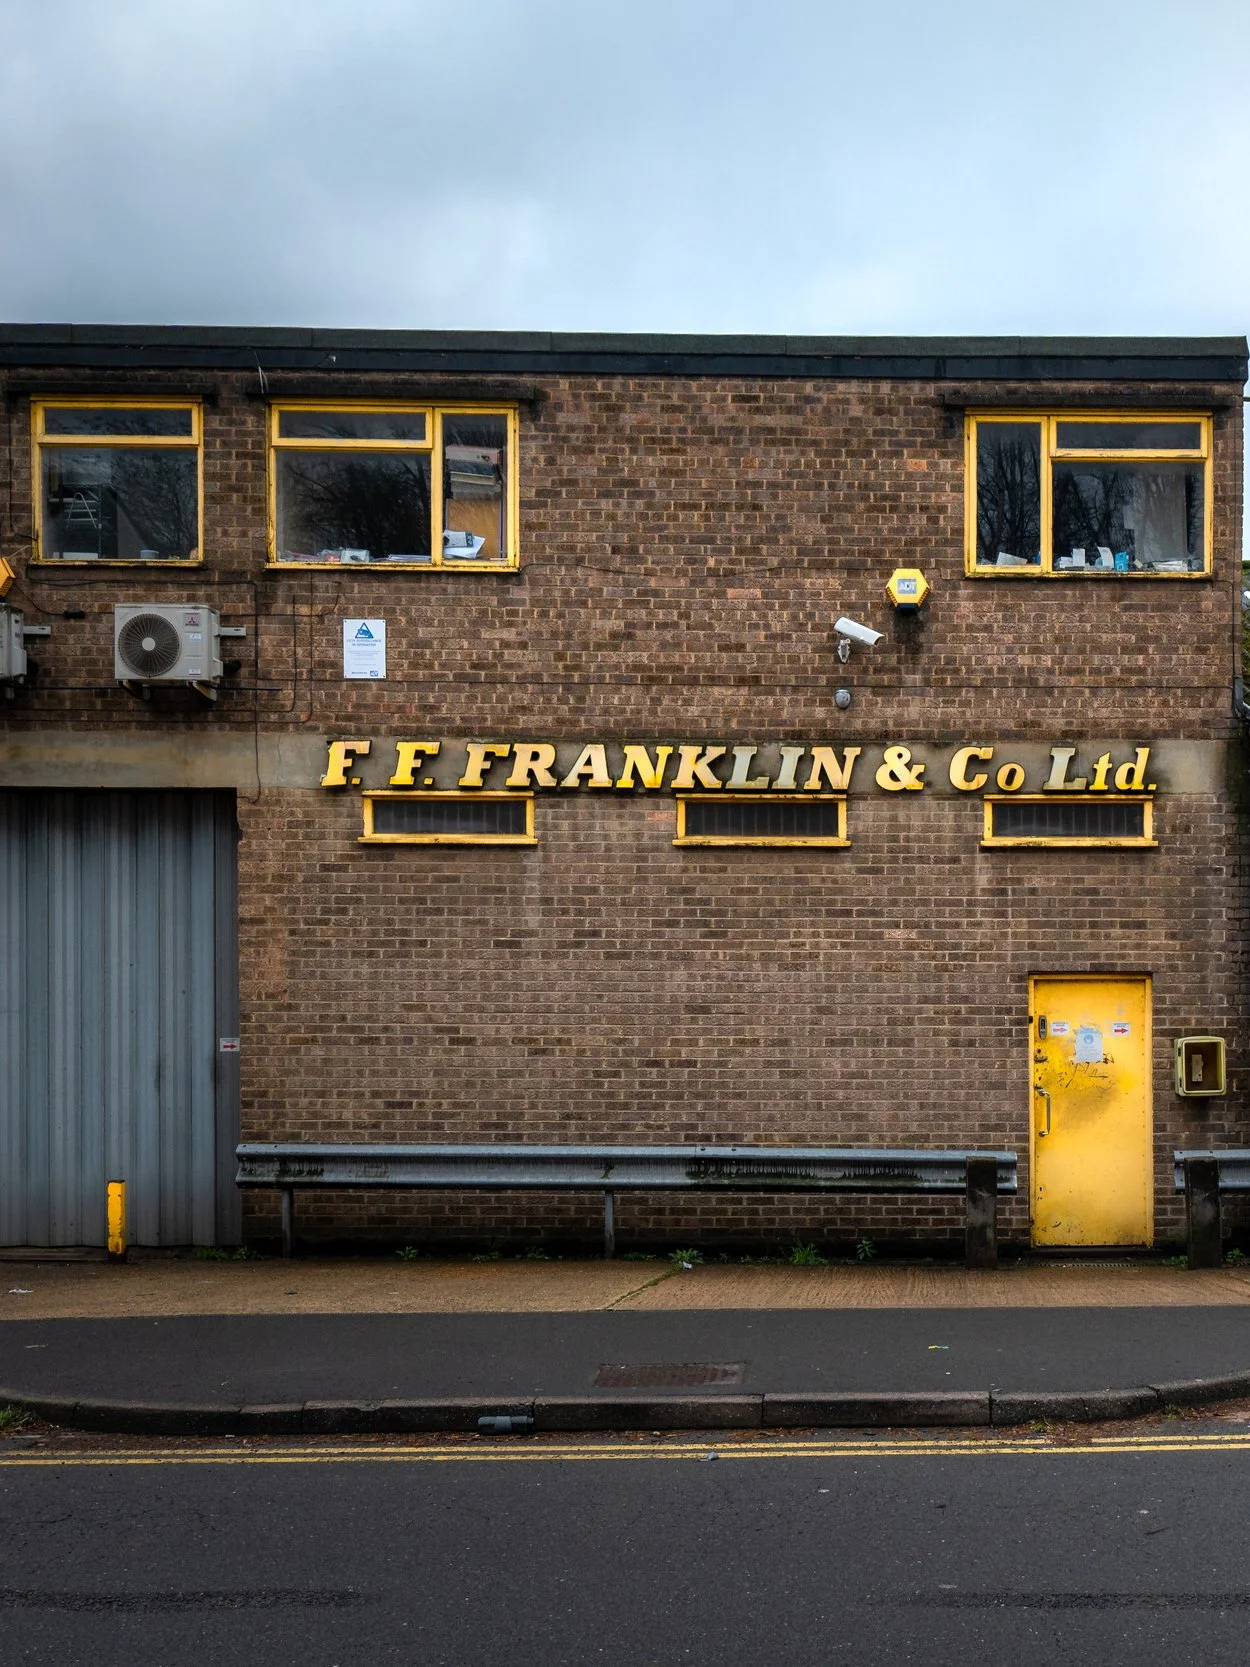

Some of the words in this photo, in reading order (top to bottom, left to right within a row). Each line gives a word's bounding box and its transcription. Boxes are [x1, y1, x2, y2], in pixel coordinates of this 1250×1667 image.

[899, 581, 916, 590] ADT
[321, 740, 371, 787] F.
[390, 741, 441, 786] F.
[458, 742, 861, 790] FRANKLIN
[875, 745, 926, 791] &
[949, 746, 1026, 792] Co
[1042, 746, 1158, 792] Ltd.
